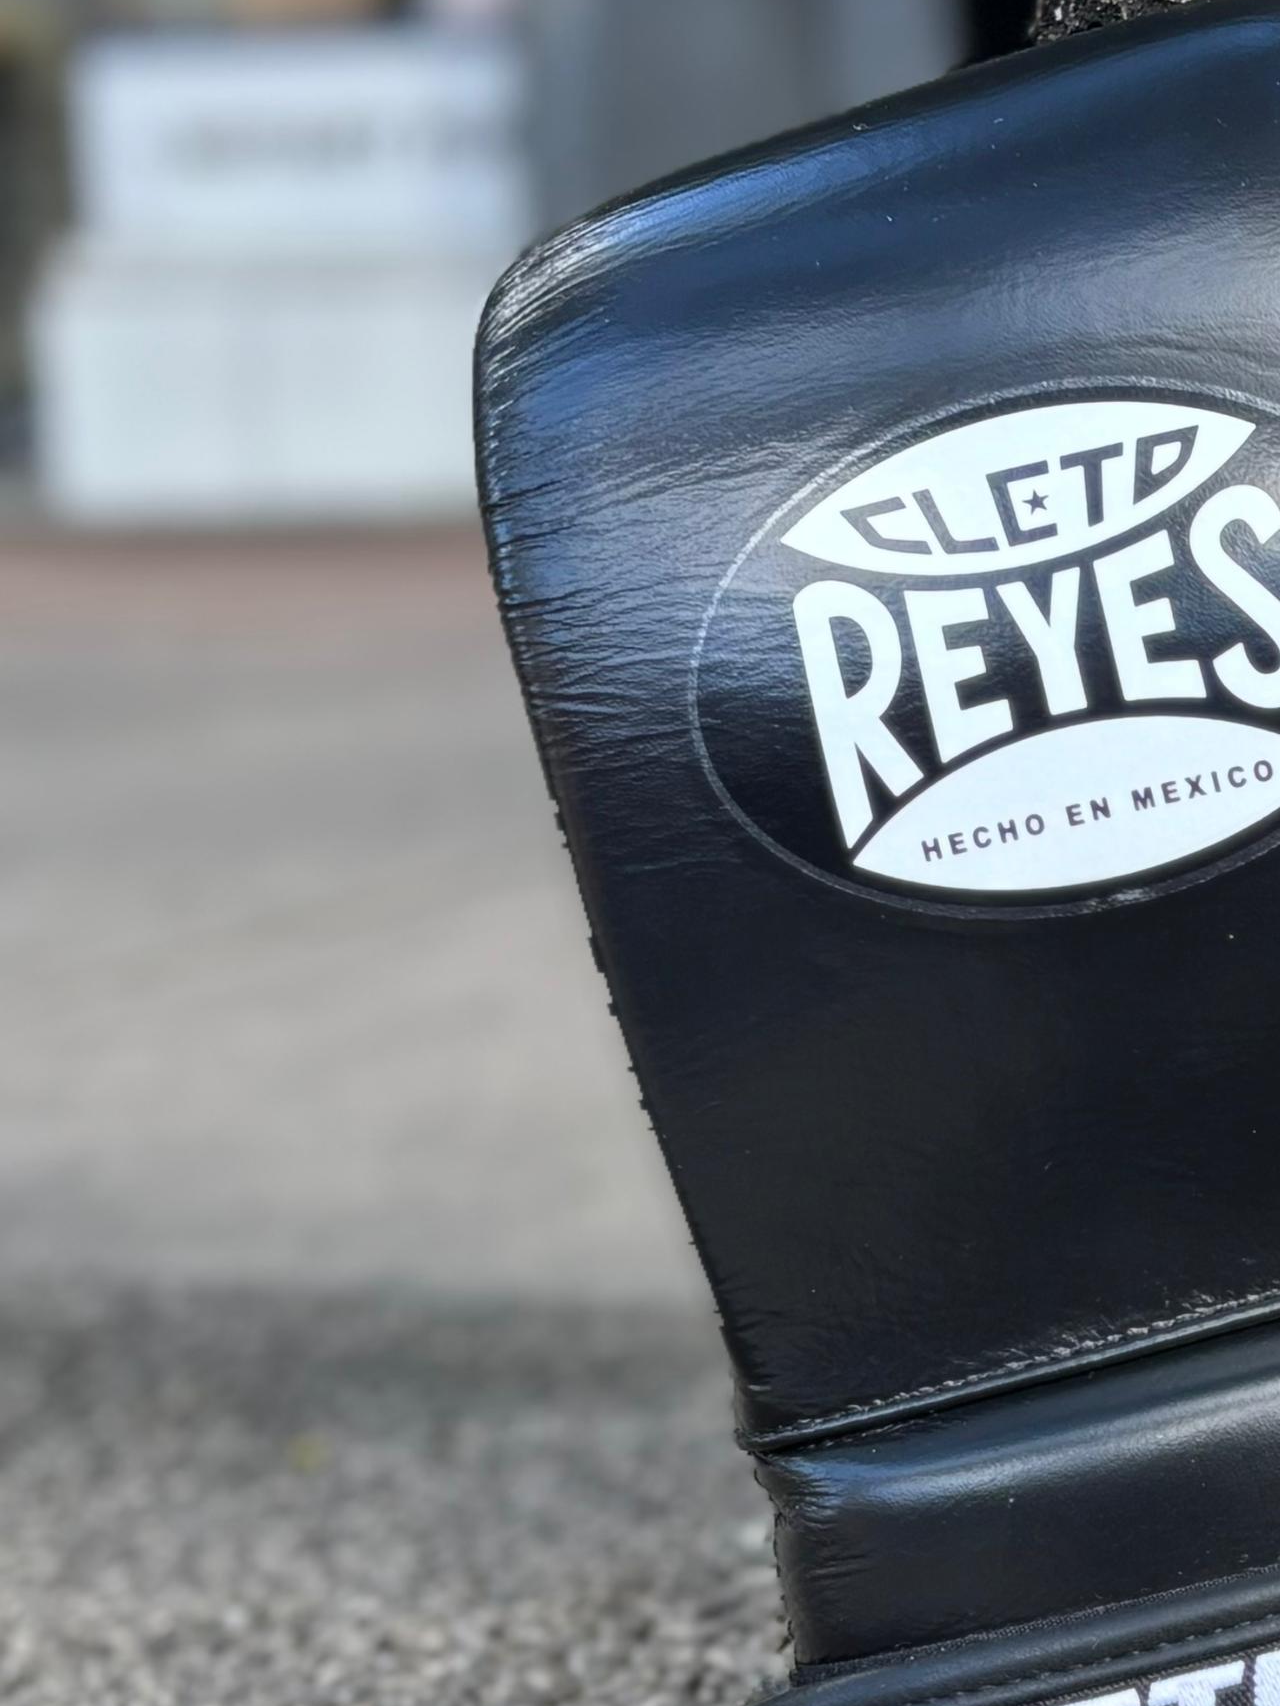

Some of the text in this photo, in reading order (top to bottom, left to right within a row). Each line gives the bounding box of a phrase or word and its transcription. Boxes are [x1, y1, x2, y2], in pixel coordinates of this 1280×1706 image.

[839, 424, 1200, 556] CLETO
[920, 759, 1275, 863] HECHO EN MEXICO
